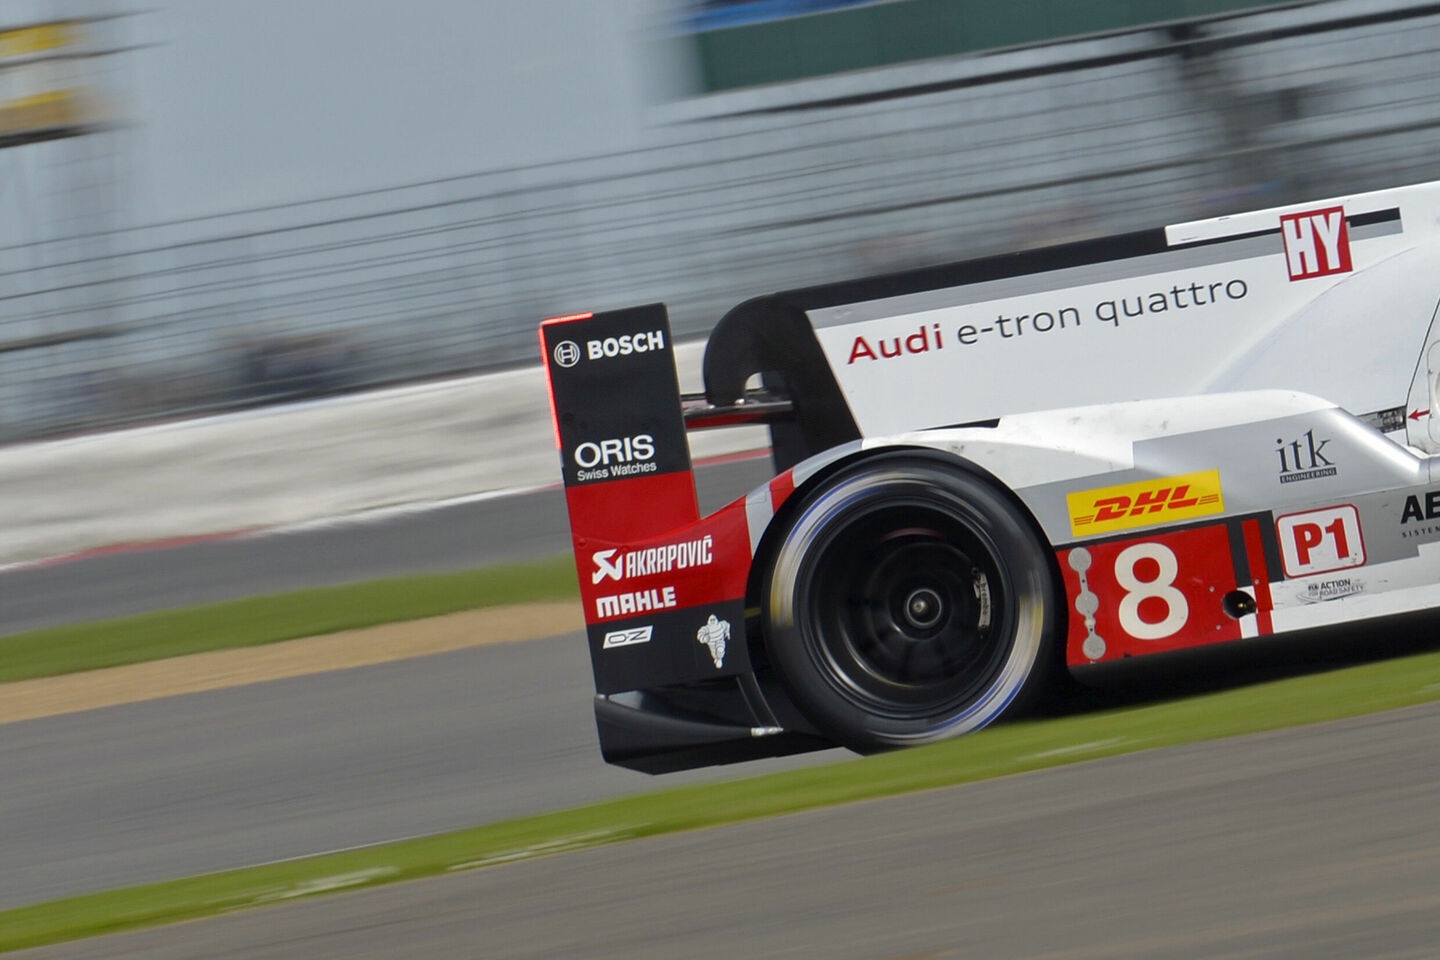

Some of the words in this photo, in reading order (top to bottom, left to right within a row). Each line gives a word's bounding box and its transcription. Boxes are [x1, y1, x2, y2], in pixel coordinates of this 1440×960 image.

[1283, 211, 1345, 277] HY
[848, 323, 943, 364] Audi
[957, 306, 1081, 345] e-tron
[1095, 278, 1249, 327] quattro
[587, 330, 665, 360] BOSCH
[574, 434, 655, 468] ORIS
[1275, 429, 1335, 473] itk
[577, 467, 609, 481] Swiss
[611, 462, 657, 477] Watches
[1093, 485, 1199, 522] DHL
[1292, 518, 1350, 566] P1
[596, 586, 677, 619] MAHLE
[1114, 542, 1189, 640] 8
[1321, 578, 1351, 590] ACTION
